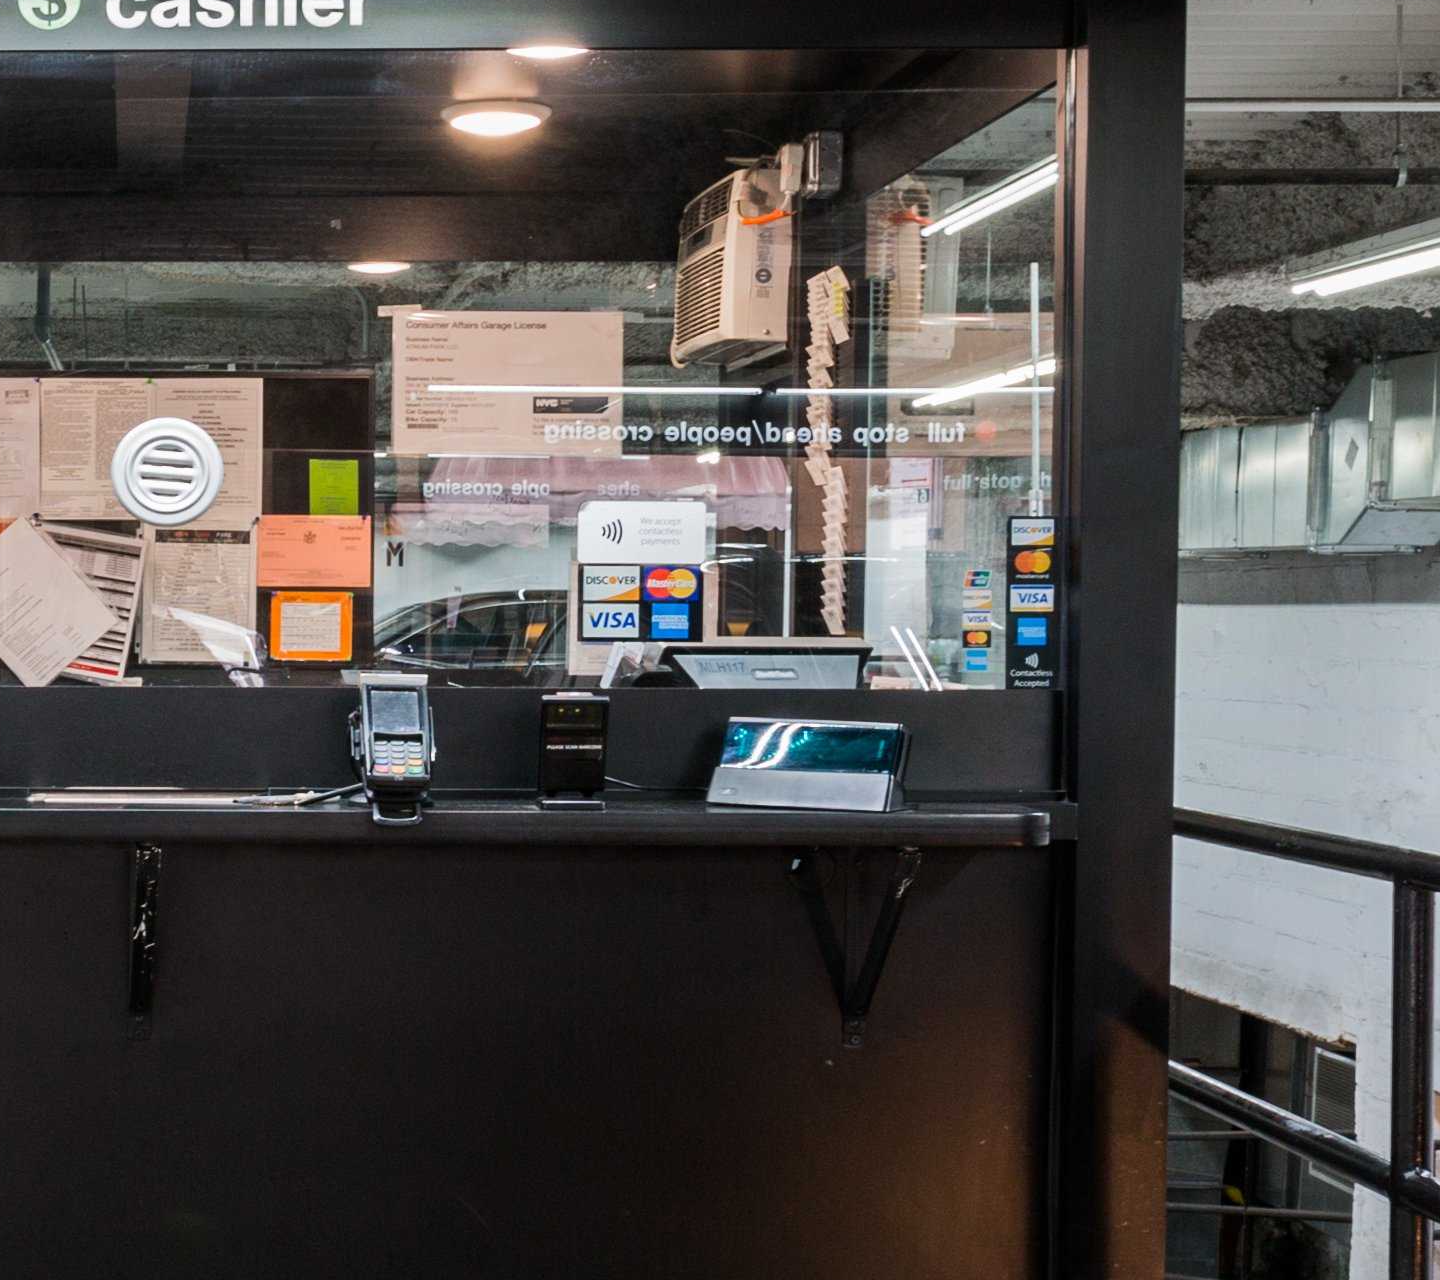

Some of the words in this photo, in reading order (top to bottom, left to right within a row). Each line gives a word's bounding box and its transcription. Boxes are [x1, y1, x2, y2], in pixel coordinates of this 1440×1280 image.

[406, 321, 449, 329] Consumer
[451, 321, 479, 329] Affairs
[481, 321, 512, 331] Garage
[514, 321, 546, 329] License
[1014, 526, 1052, 534] DISCOVER
[586, 576, 637, 585] DISCOVER
[1018, 592, 1048, 604] VISA
[590, 612, 636, 628] VISA
[968, 615, 988, 623] VISA
[1010, 669, 1053, 678] Contactless
[1014, 679, 1050, 688] Accepted
